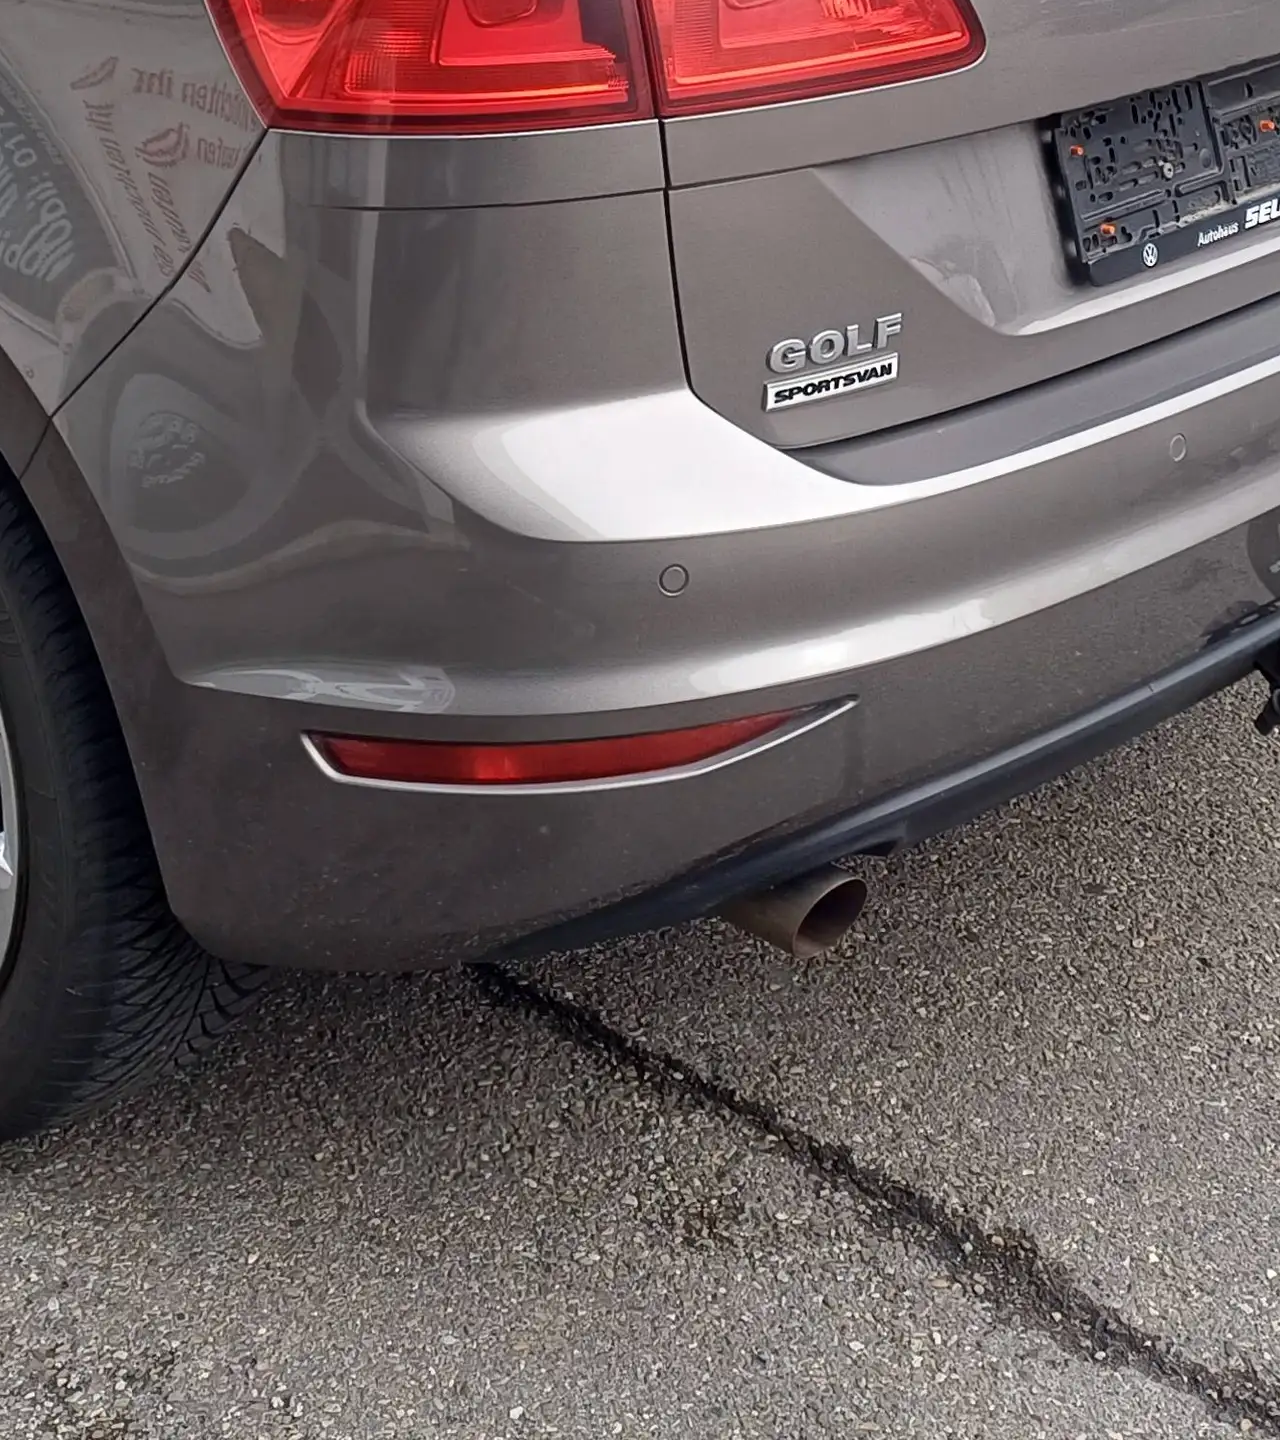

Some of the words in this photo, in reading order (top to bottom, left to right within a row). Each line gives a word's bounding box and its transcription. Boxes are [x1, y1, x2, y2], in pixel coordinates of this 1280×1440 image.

[1197, 222, 1239, 247] Autohaus
[767, 312, 903, 374] GOLF
[773, 362, 893, 404] SPORTSVAN
